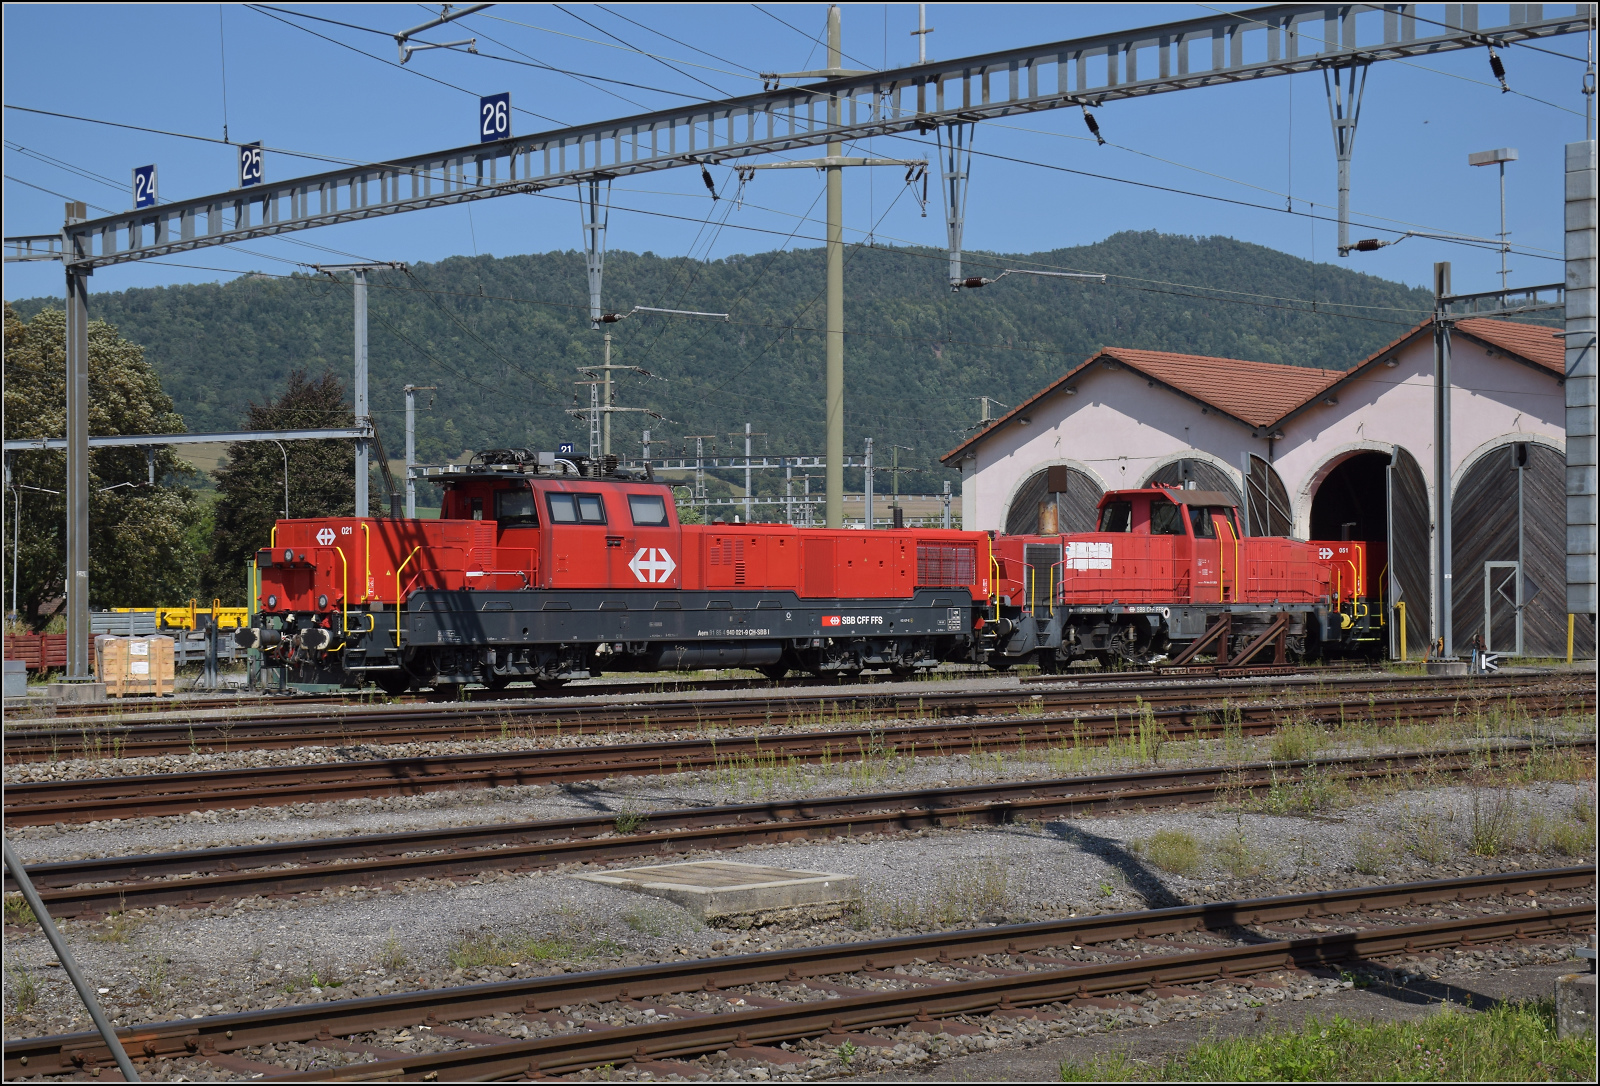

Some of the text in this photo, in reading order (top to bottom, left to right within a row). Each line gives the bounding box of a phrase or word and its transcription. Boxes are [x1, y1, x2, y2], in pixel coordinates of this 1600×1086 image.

[482, 101, 507, 135] 26
[242, 148, 261, 181] 25
[136, 171, 155, 202] 24
[560, 445, 571, 453] 21
[341, 526, 352, 535] 021
[841, 615, 883, 625] SBB CFF FFS
